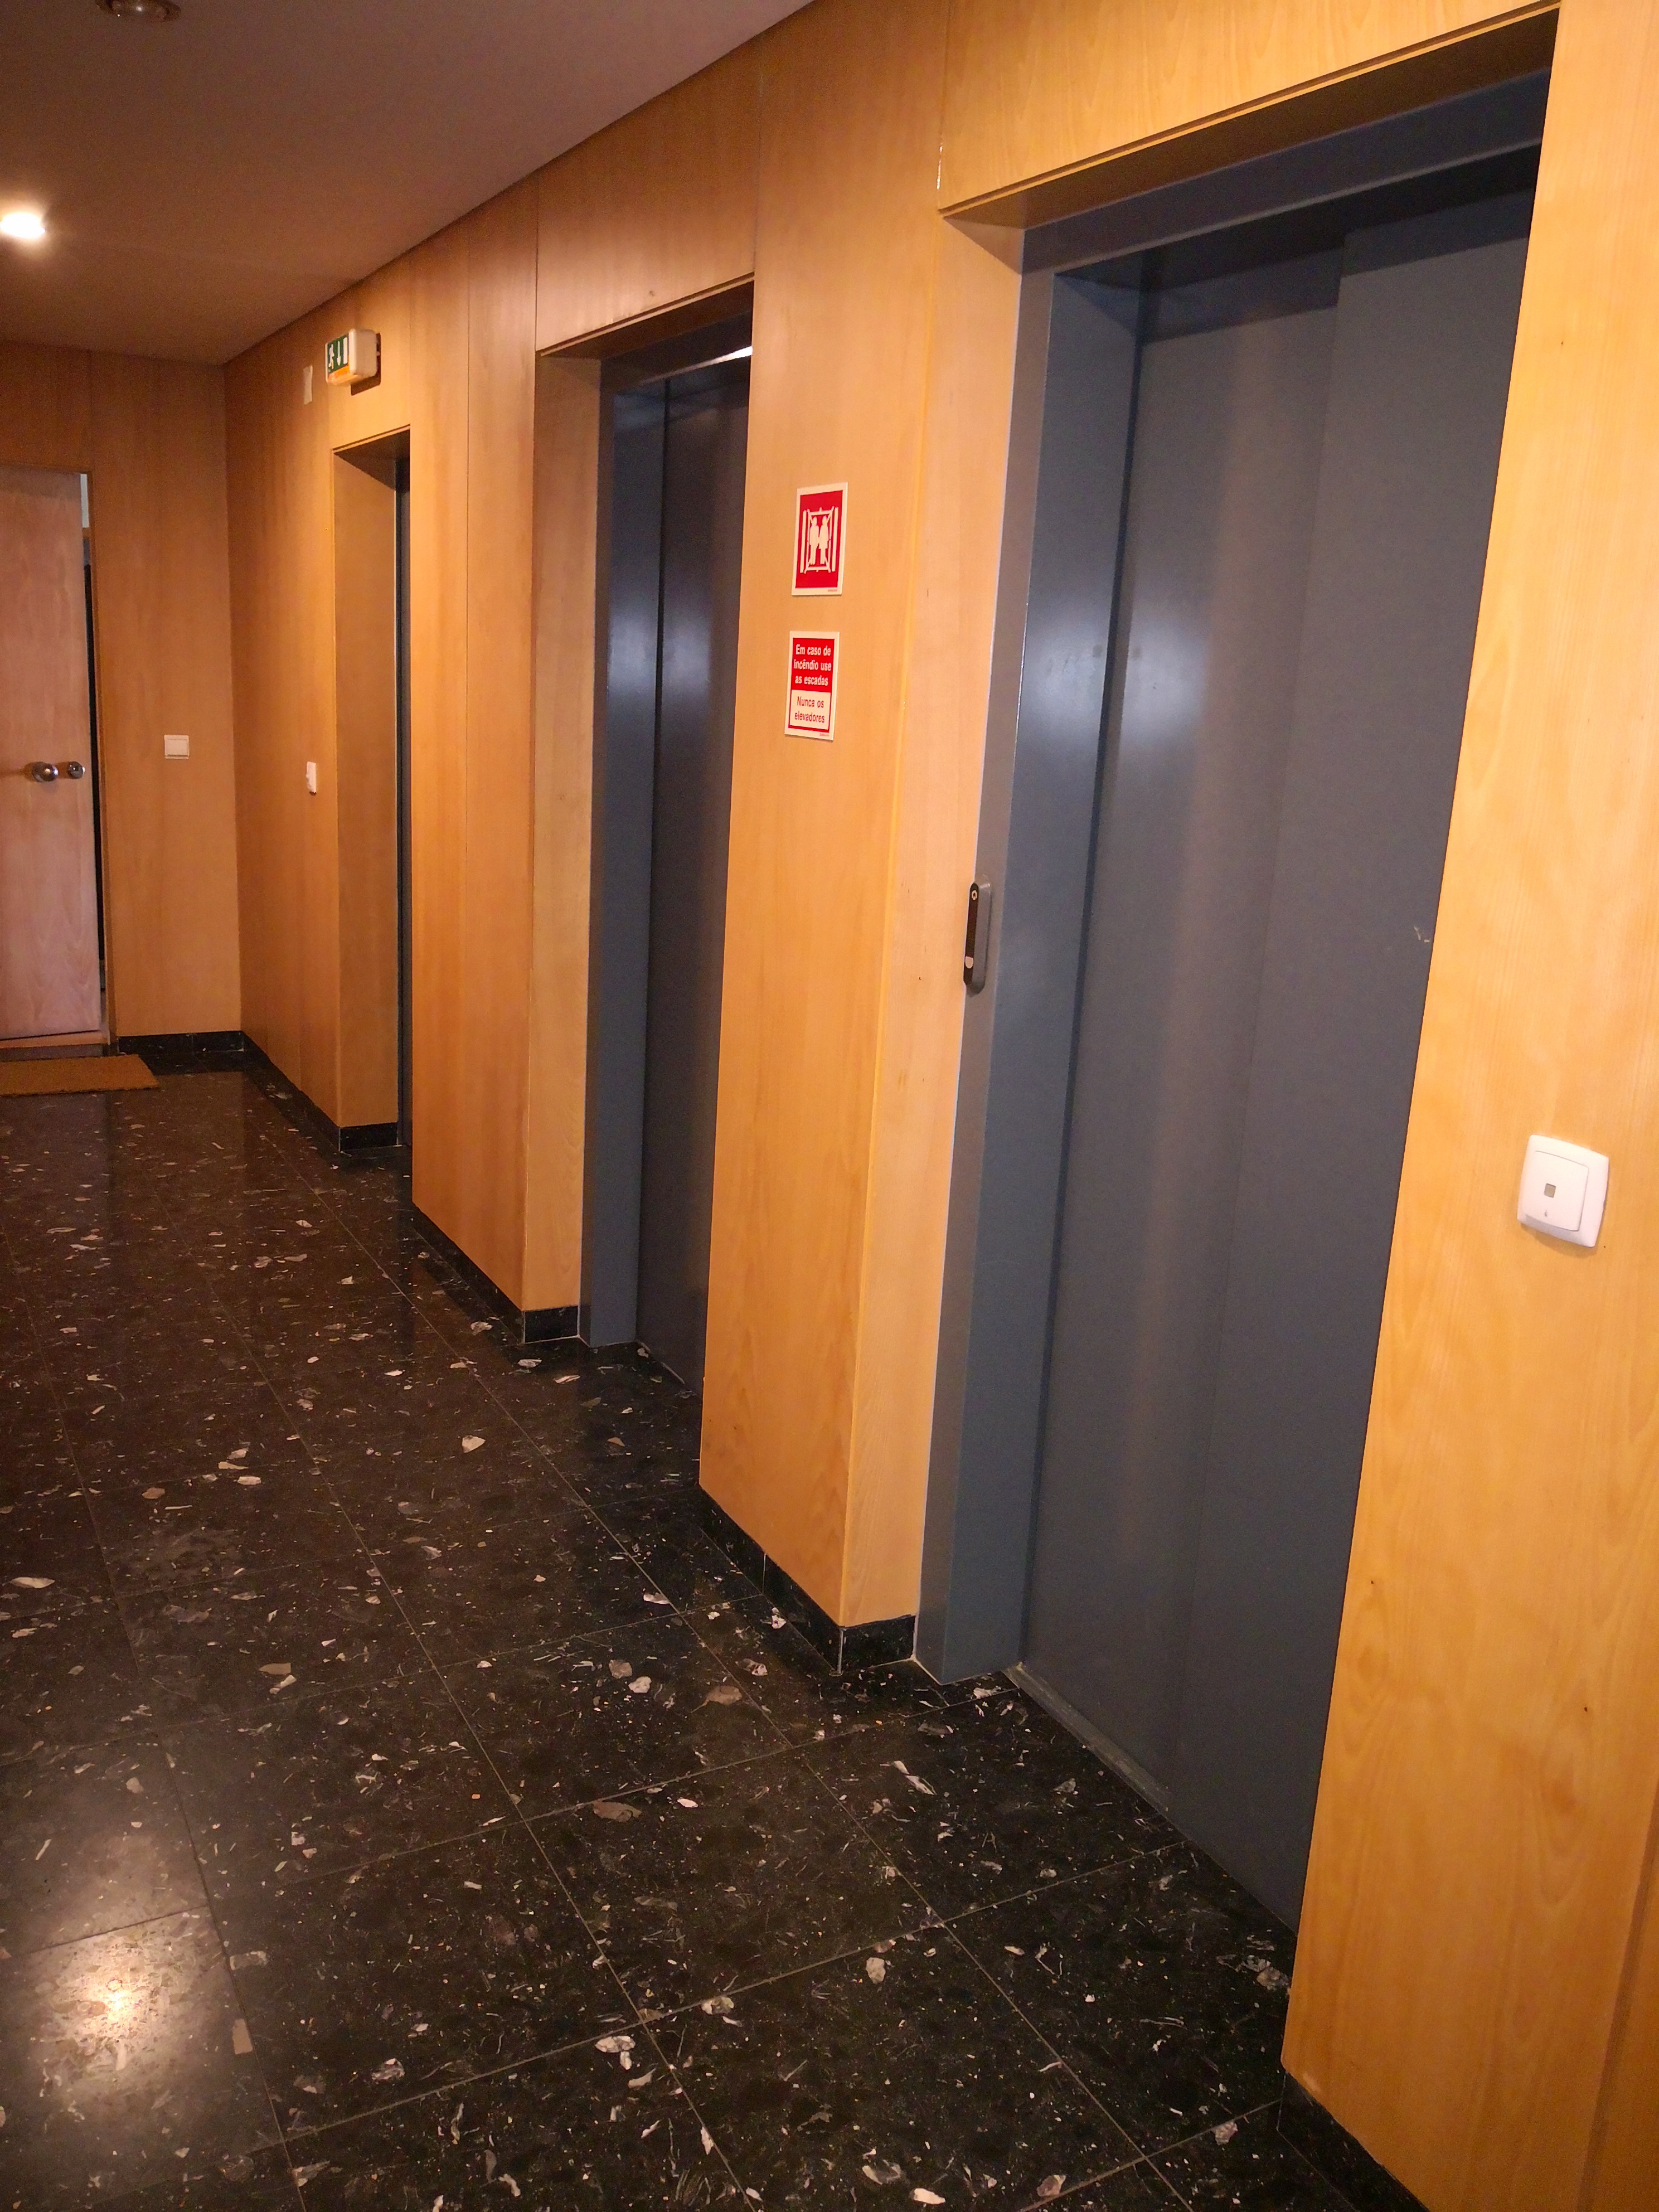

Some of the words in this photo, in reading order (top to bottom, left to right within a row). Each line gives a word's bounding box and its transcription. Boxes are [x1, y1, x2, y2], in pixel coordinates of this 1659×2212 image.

[795, 644, 805, 655] Em
[807, 646, 821, 656] caso
[823, 645, 831, 656] de
[793, 658, 818, 671] incêndio
[821, 662, 832, 671] use
[795, 675, 802, 684] as
[804, 675, 828, 686] escadas
[797, 696, 815, 707] Nunca
[817, 700, 824, 708] os
[794, 711, 825, 723] elevadores
